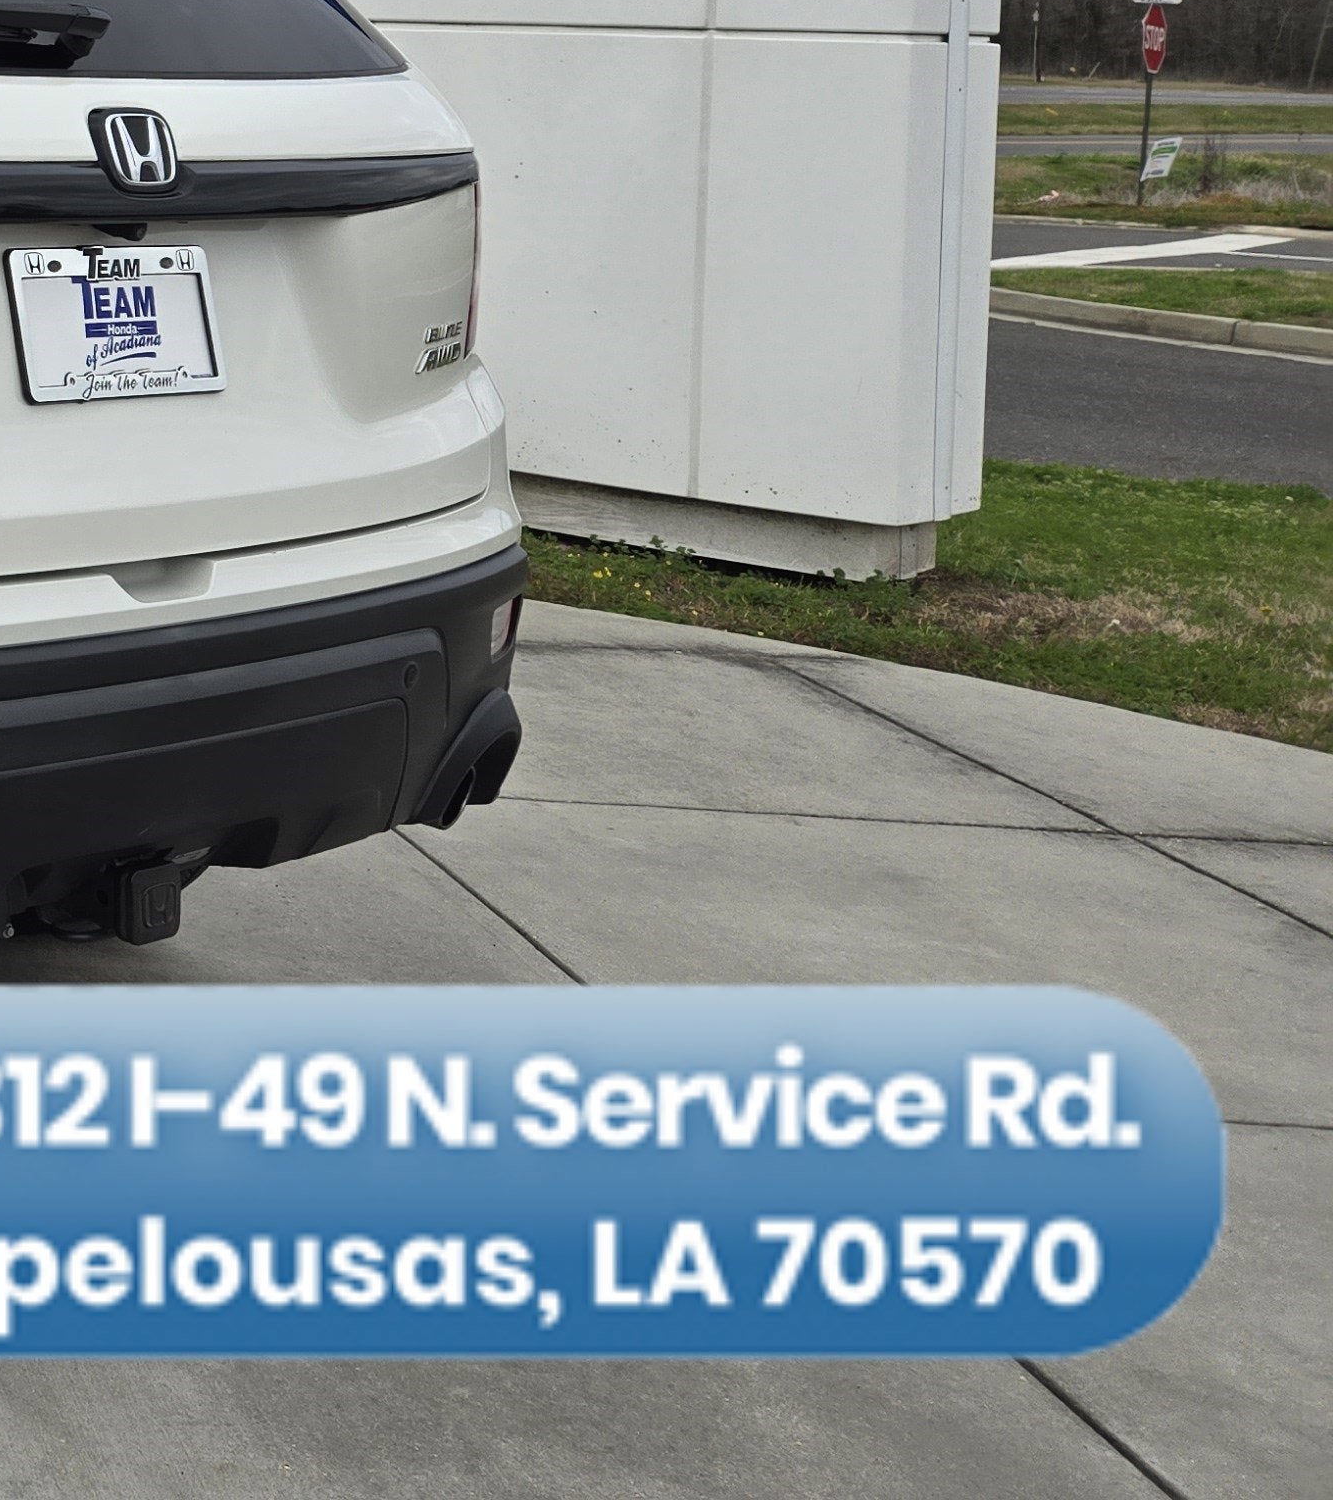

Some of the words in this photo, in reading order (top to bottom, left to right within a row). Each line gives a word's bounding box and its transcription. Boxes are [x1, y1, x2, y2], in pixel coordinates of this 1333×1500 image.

[1144, 25, 1165, 51] STOP
[83, 248, 140, 279] TEAM
[72, 276, 156, 319] TEAM
[107, 324, 137, 335] Honda
[85, 344, 98, 371] of
[100, 334, 162, 359] Acadiana
[415, 342, 461, 375] AWD
[82, 373, 112, 399] Join
[142, 372, 178, 390] Team!
